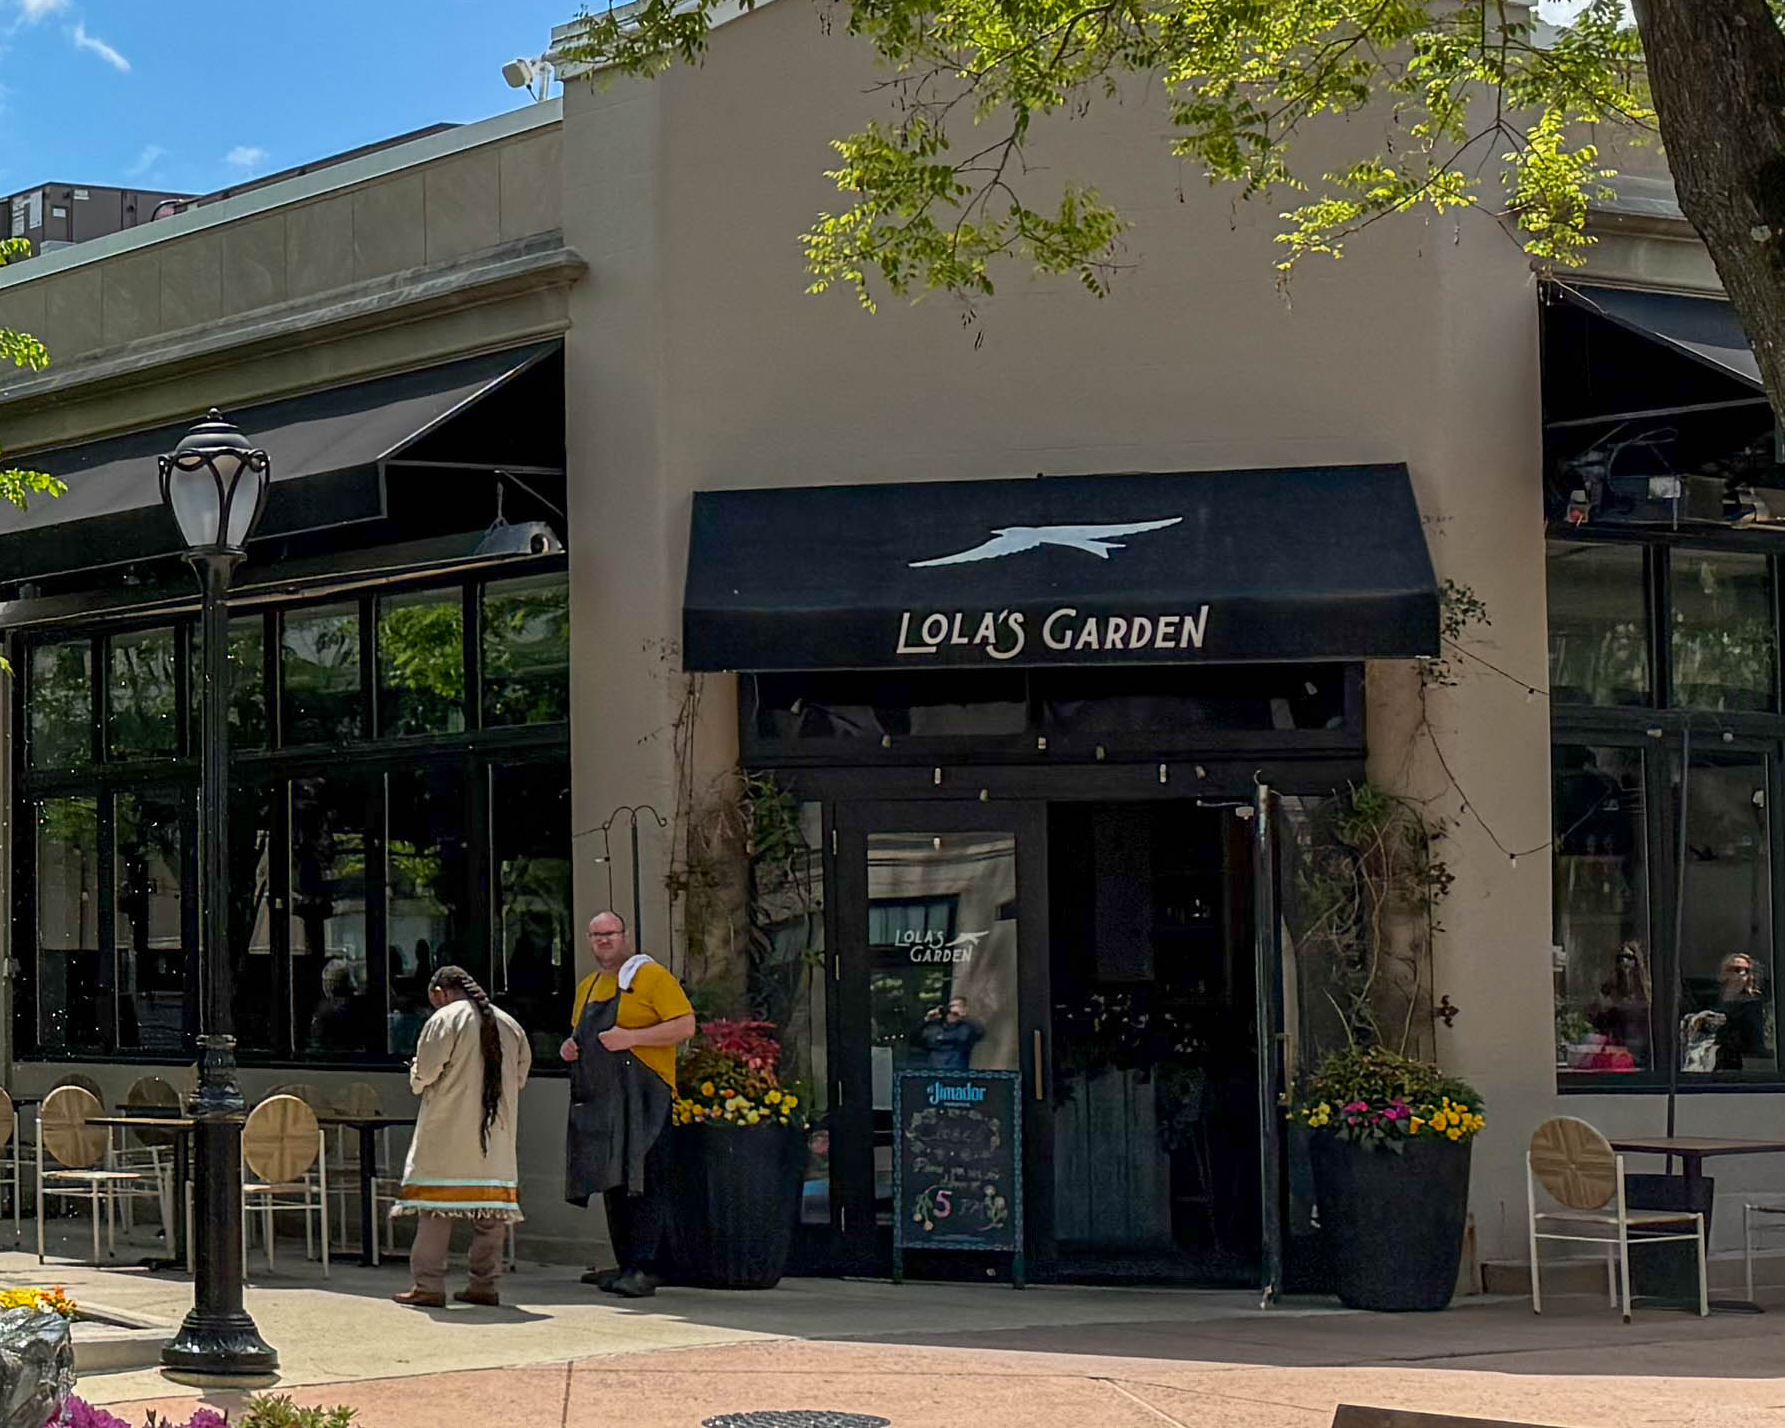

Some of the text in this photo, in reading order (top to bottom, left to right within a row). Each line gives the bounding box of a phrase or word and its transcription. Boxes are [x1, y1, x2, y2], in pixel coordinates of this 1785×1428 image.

[896, 605, 1209, 659] LOLA'S GARDEN
[894, 929, 944, 949] LOLA'S
[910, 944, 973, 963] GARDEN
[933, 1190, 953, 1218] 5
